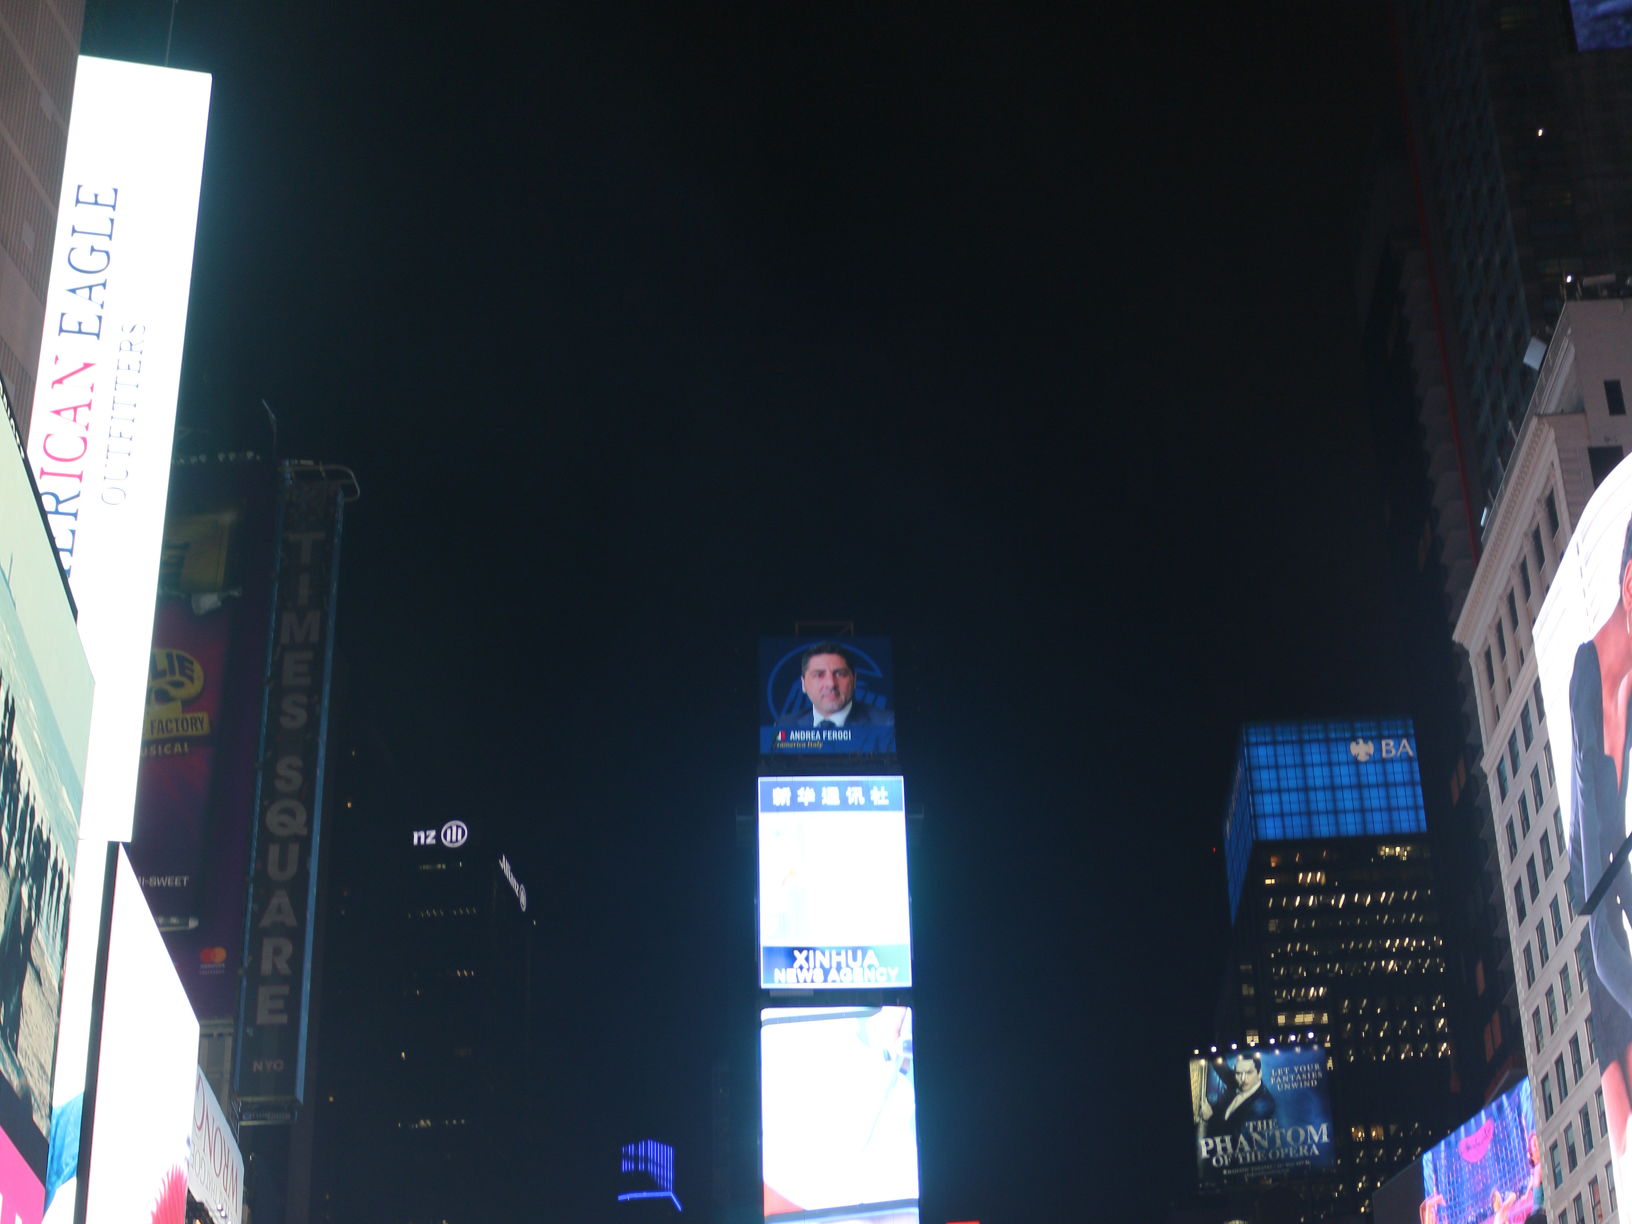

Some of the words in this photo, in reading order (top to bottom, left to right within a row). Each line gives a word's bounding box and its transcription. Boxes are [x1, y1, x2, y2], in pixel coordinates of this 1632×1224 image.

[57, 183, 119, 341] EAGLE
[100, 322, 147, 508] OUTFITTERS
[39, 356, 97, 578] RICAN
[279, 532, 326, 731] TIMES
[150, 715, 206, 735] FACTORY
[790, 729, 820, 741] ANDREA
[256, 756, 308, 1026] SQUARE
[793, 949, 880, 969] XINHUA
[773, 967, 824, 984] NEWS
[827, 966, 899, 984] AGENCY
[1199, 1122, 1330, 1160] PHANTOM
[1246, 1118, 1278, 1133] THE
[1212, 1153, 1231, 1168] OF
[1234, 1149, 1266, 1165] THE
[1267, 1143, 1320, 1162] OPERA
